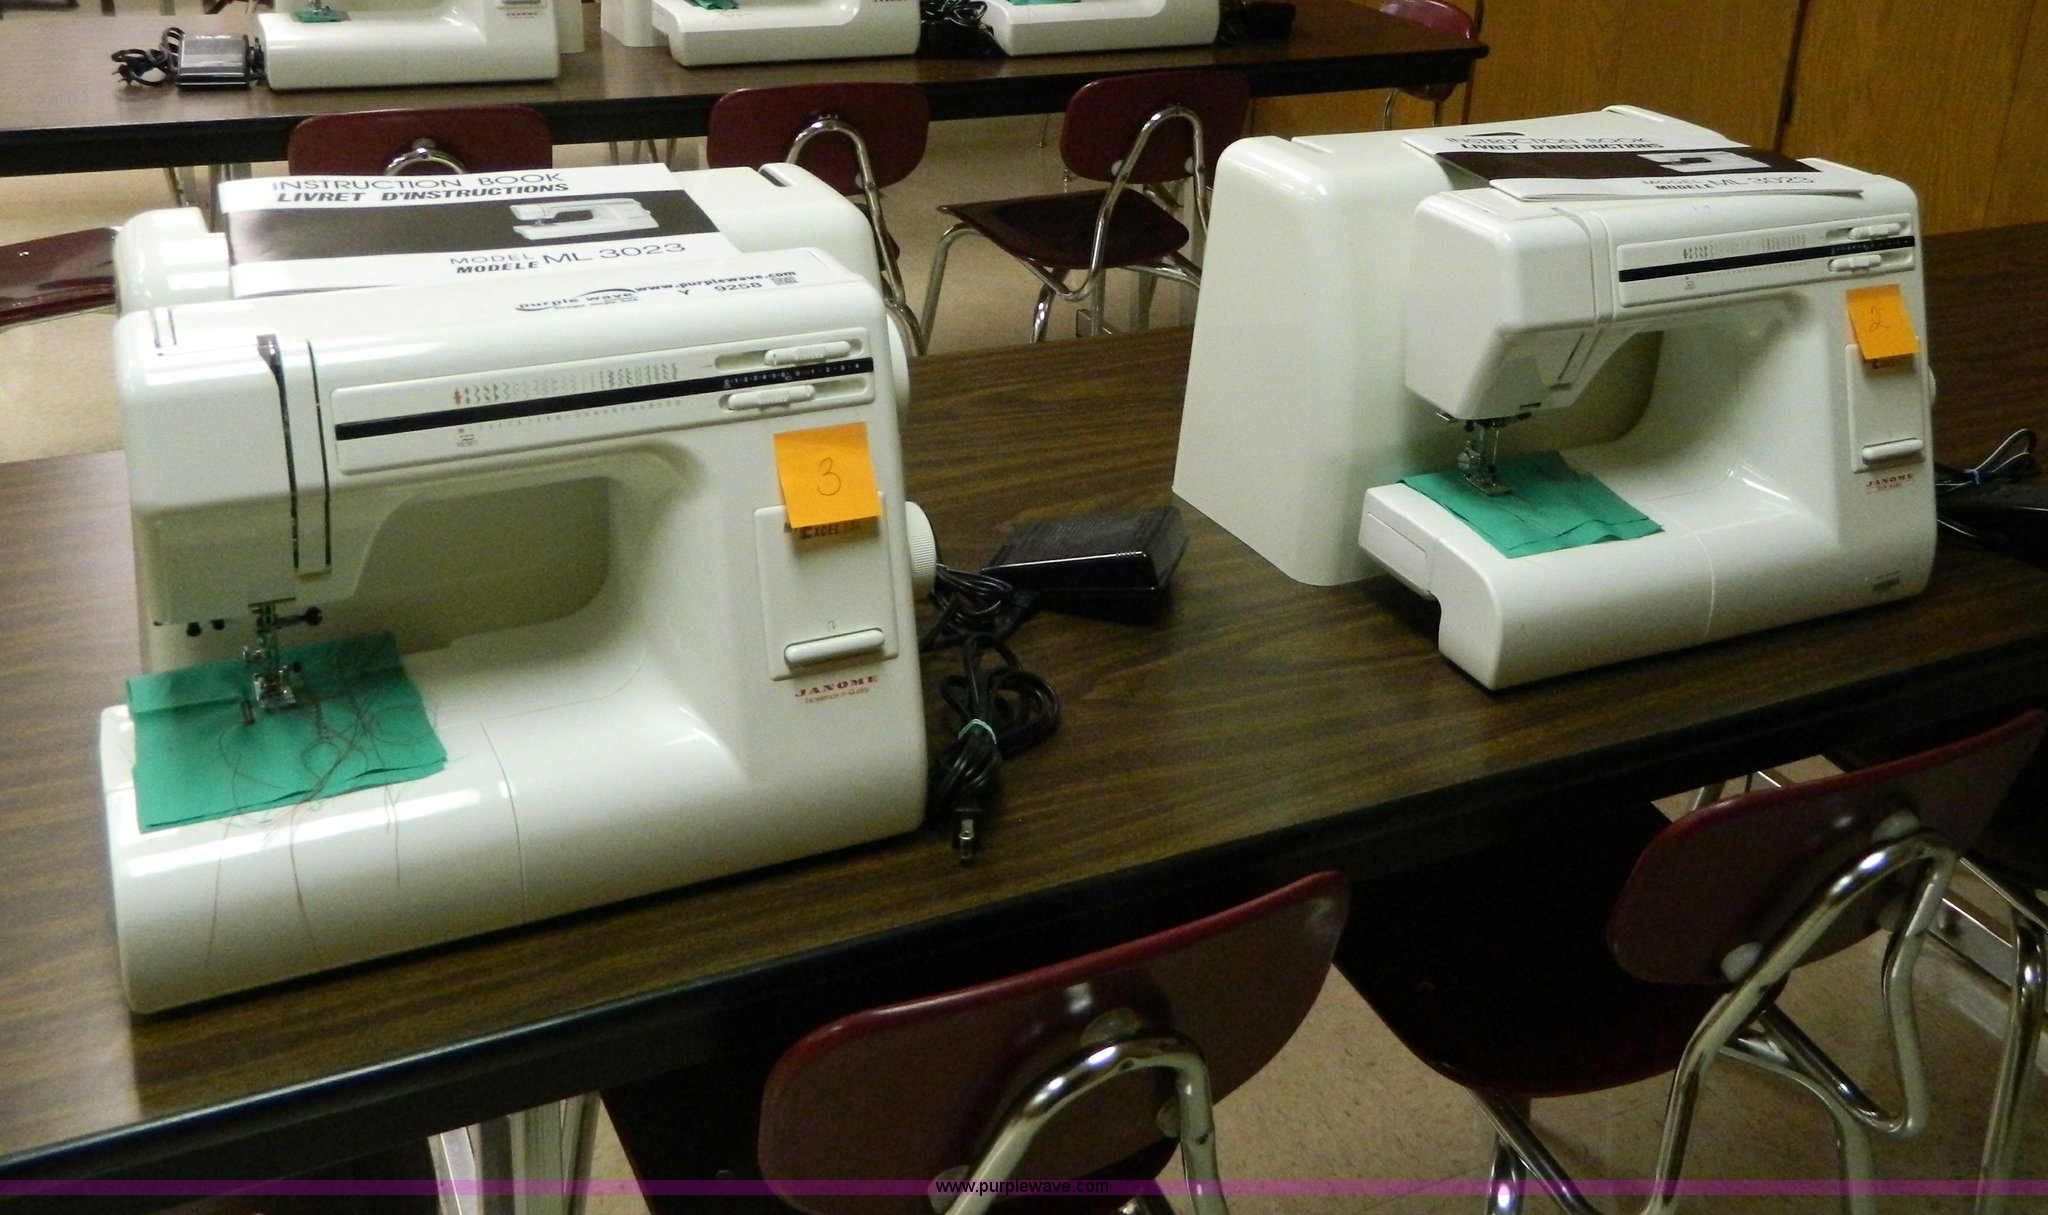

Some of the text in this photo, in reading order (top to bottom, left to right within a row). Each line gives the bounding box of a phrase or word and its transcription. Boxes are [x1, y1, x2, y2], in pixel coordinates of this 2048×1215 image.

[1460, 143, 1519, 151] LIVRET
[272, 173, 564, 191] INSTRUCTION BOOK
[277, 183, 570, 202] LIVRET D'INSTRUCTIONS
[450, 253, 536, 265] MODEL
[542, 243, 687, 265] ML 3023
[634, 270, 797, 292] www.purplewave.com
[714, 282, 763, 293] 9258
[519, 298, 580, 309] purple
[585, 293, 634, 302] wave
[1869, 305, 1890, 333] 2
[816, 456, 841, 496] 3
[794, 674, 879, 698] JANOME
